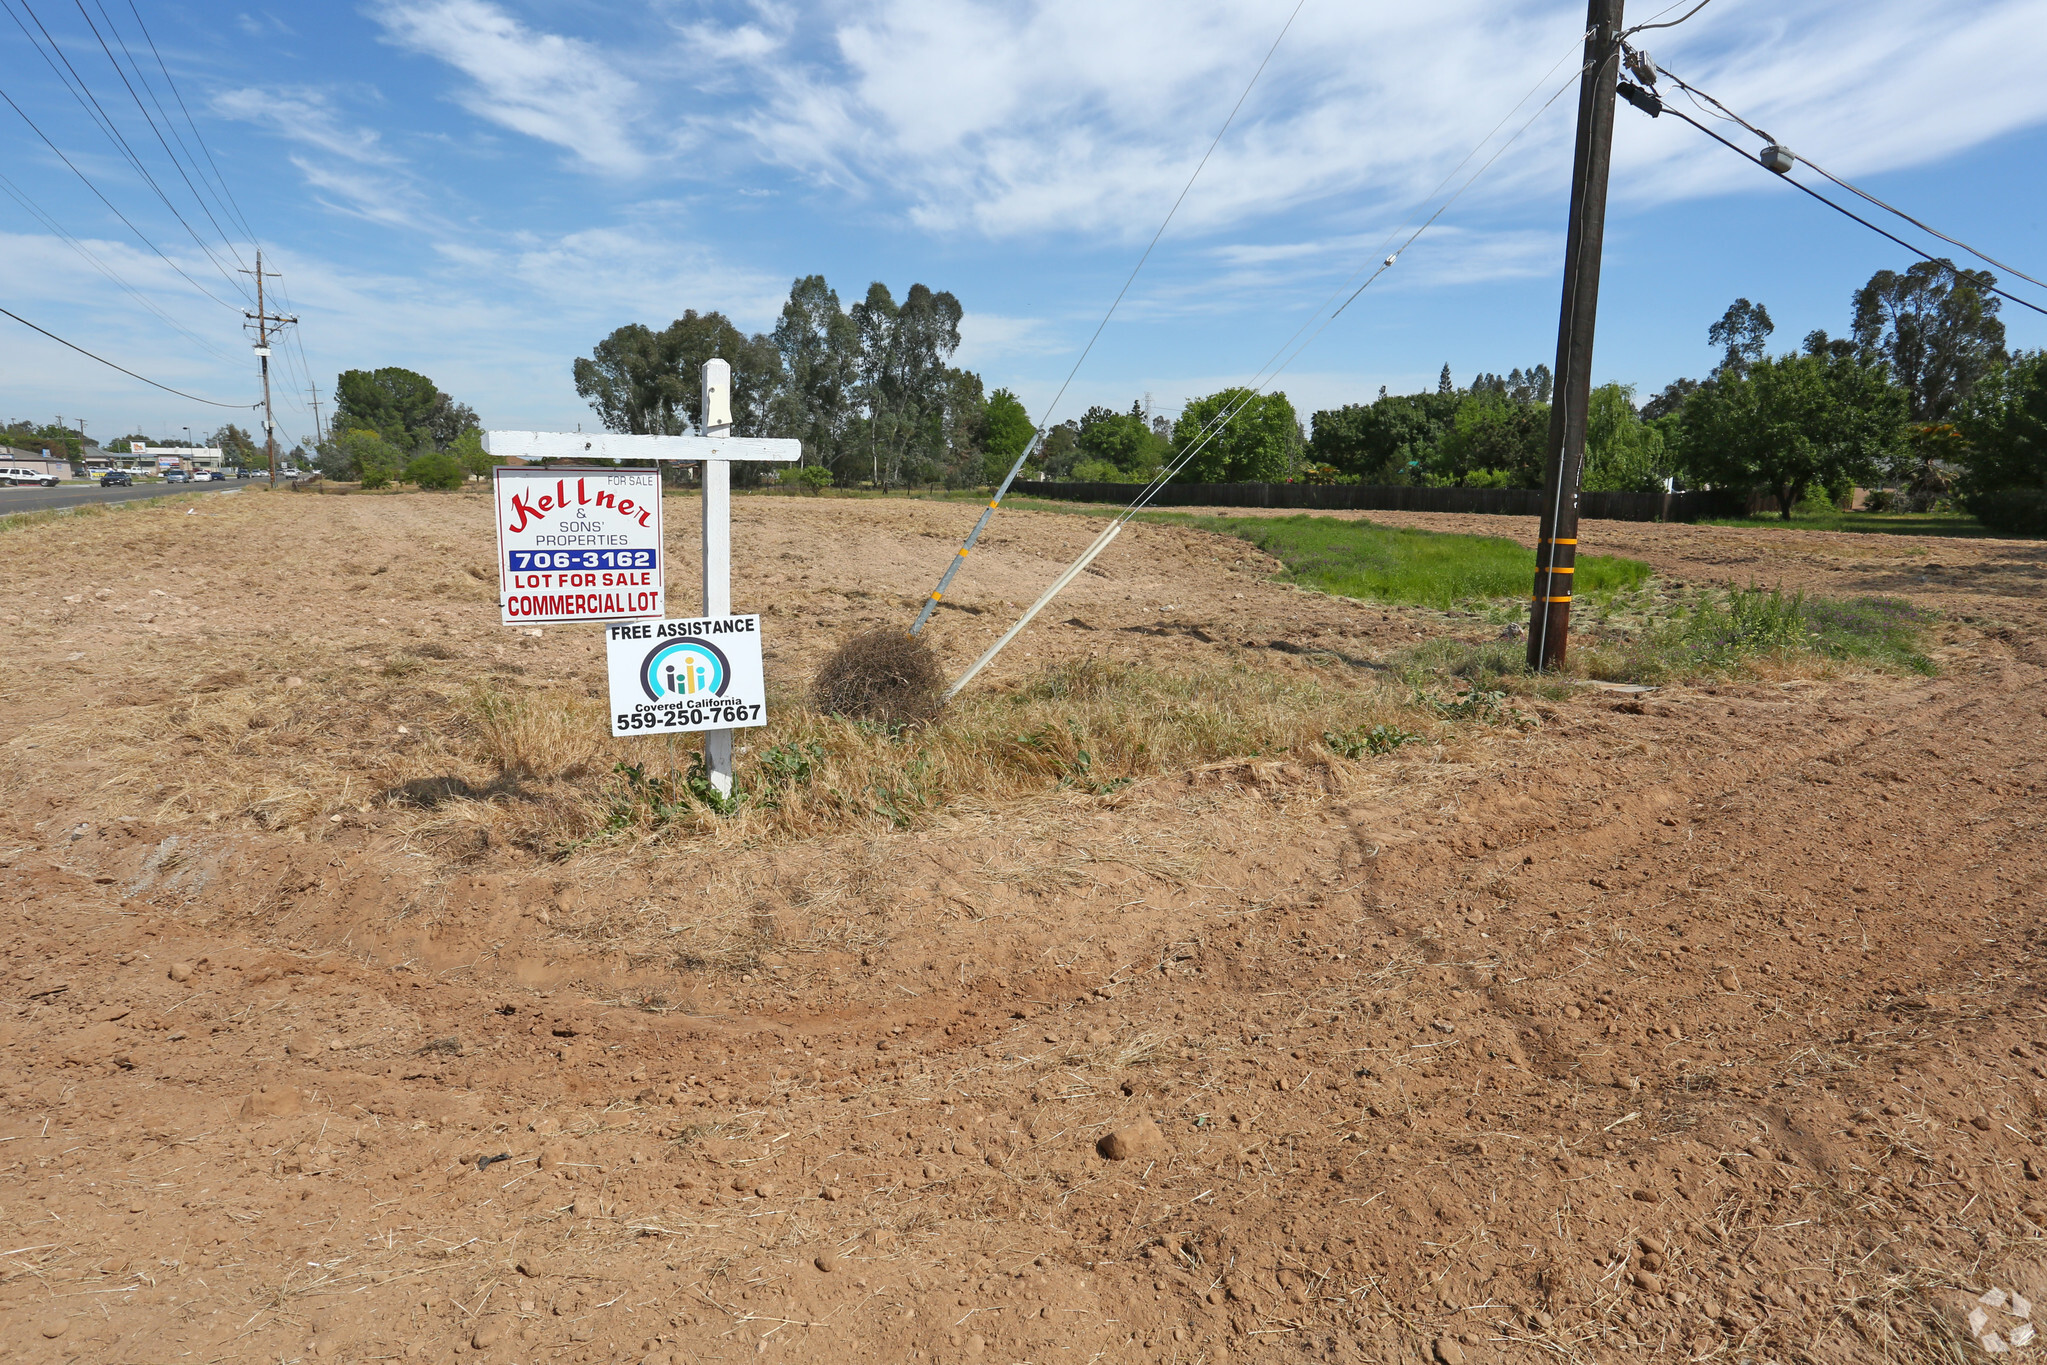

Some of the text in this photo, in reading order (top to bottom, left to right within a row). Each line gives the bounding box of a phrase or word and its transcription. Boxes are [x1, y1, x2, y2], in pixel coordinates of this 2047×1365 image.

[608, 476, 653, 486] FOR SALE
[509, 477, 652, 533] Kellner
[576, 508, 587, 518] &
[536, 535, 628, 546] PROPERTIES
[515, 552, 650, 568] 706-3162
[515, 573, 651, 588] LOT FOR SALE
[508, 592, 658, 616] COMMERCIAL LOT
[611, 618, 755, 640] FREE ASSISTANCE
[635, 697, 742, 712] Covered California
[617, 705, 761, 730] 559-250-7667
